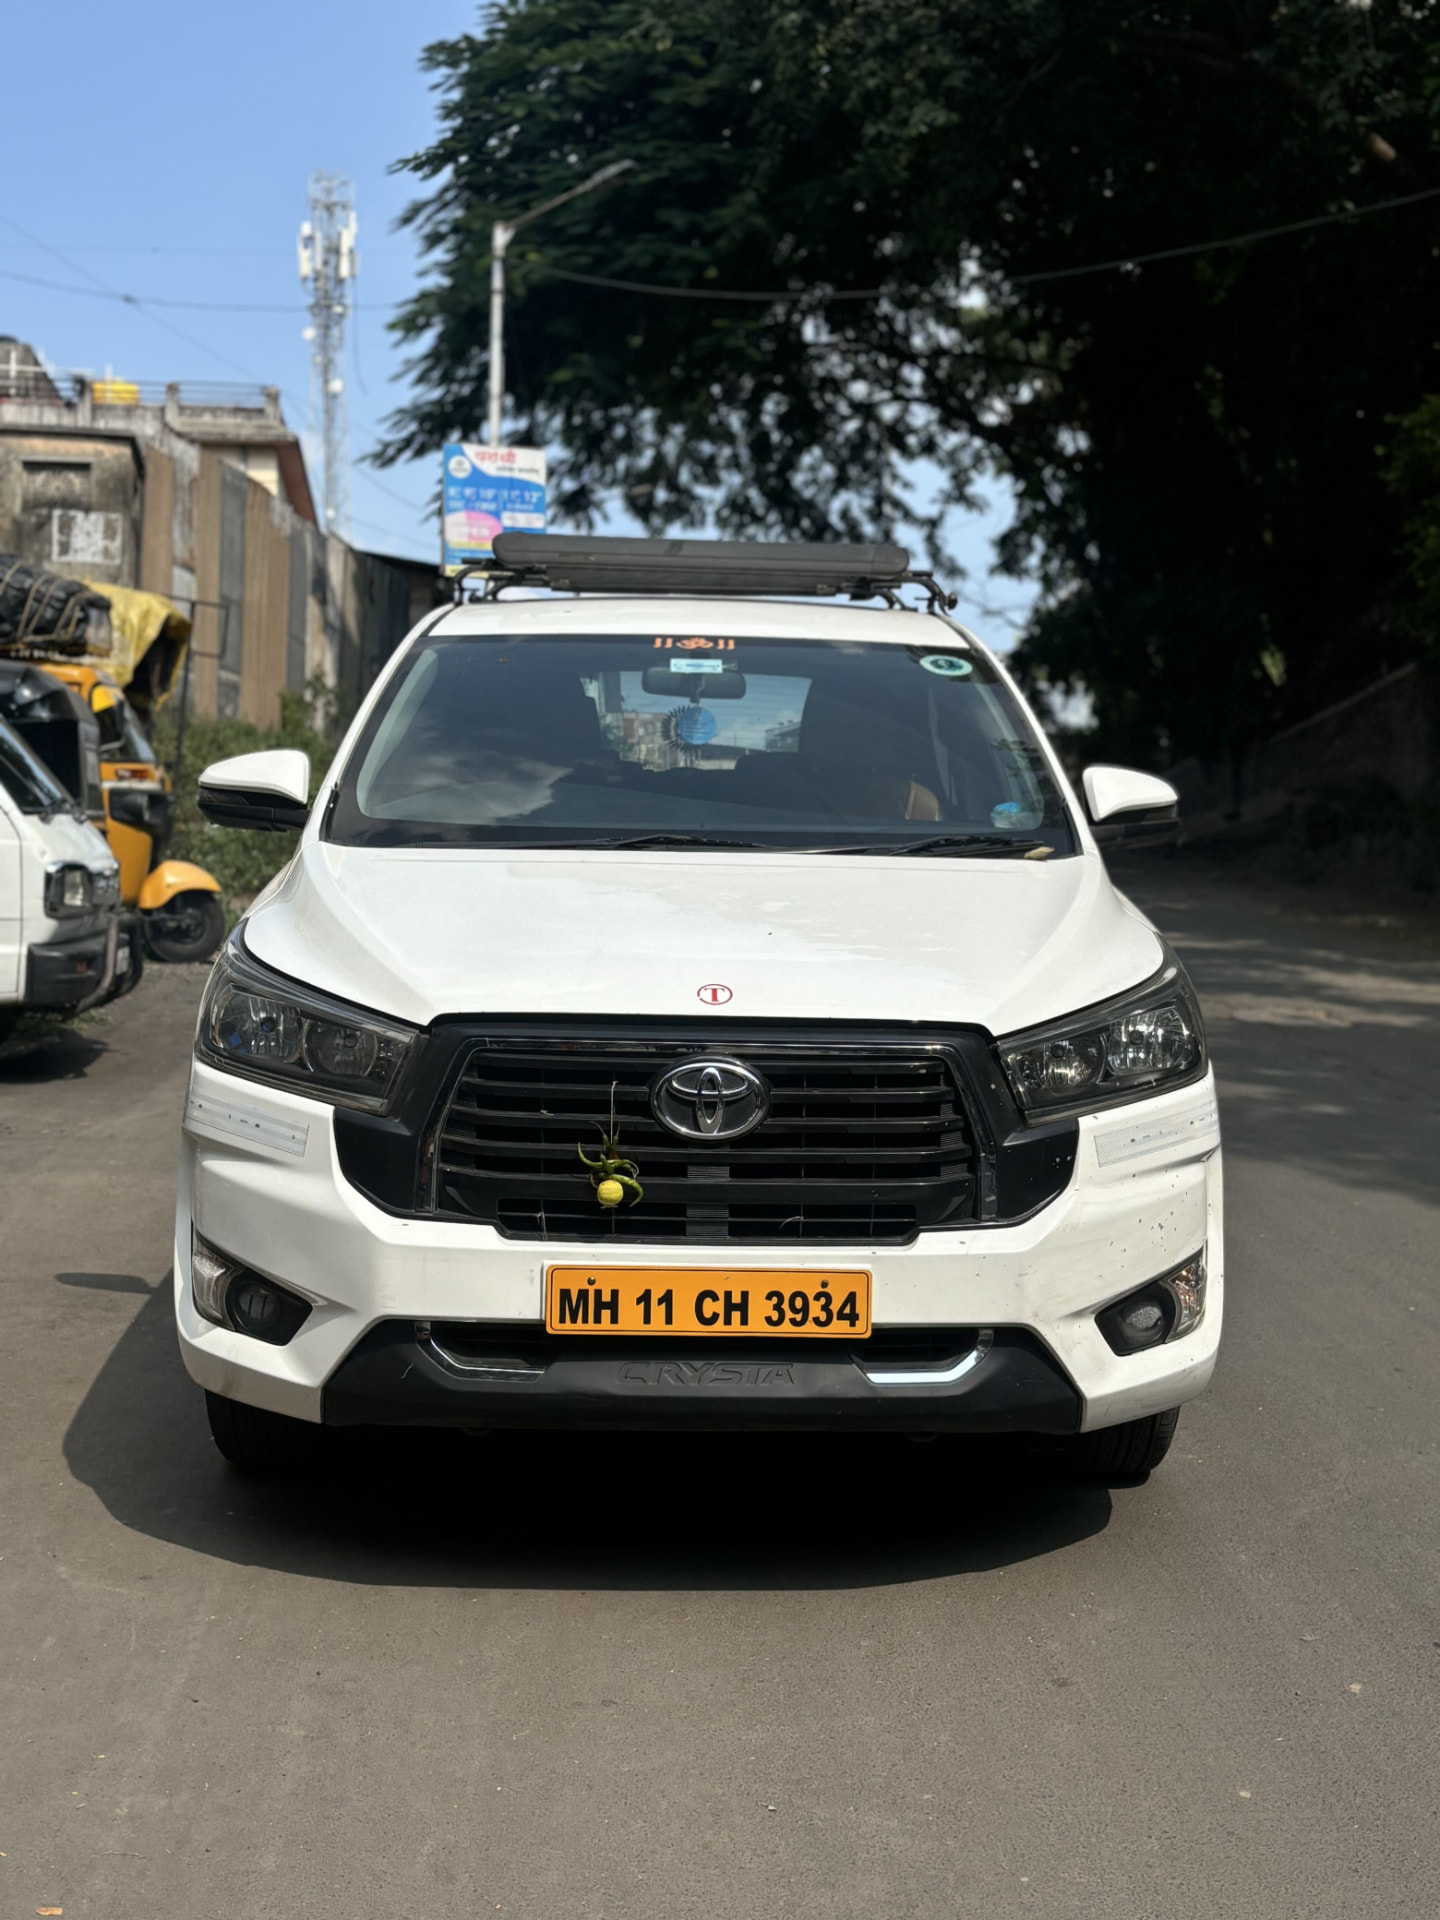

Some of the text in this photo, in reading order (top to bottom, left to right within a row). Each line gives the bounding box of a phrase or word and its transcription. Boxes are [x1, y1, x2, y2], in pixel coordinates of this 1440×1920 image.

[704, 987, 725, 1002] T
[558, 1288, 860, 1328] MH 11 CH 3934
[616, 1360, 795, 1386] CRYSTA
